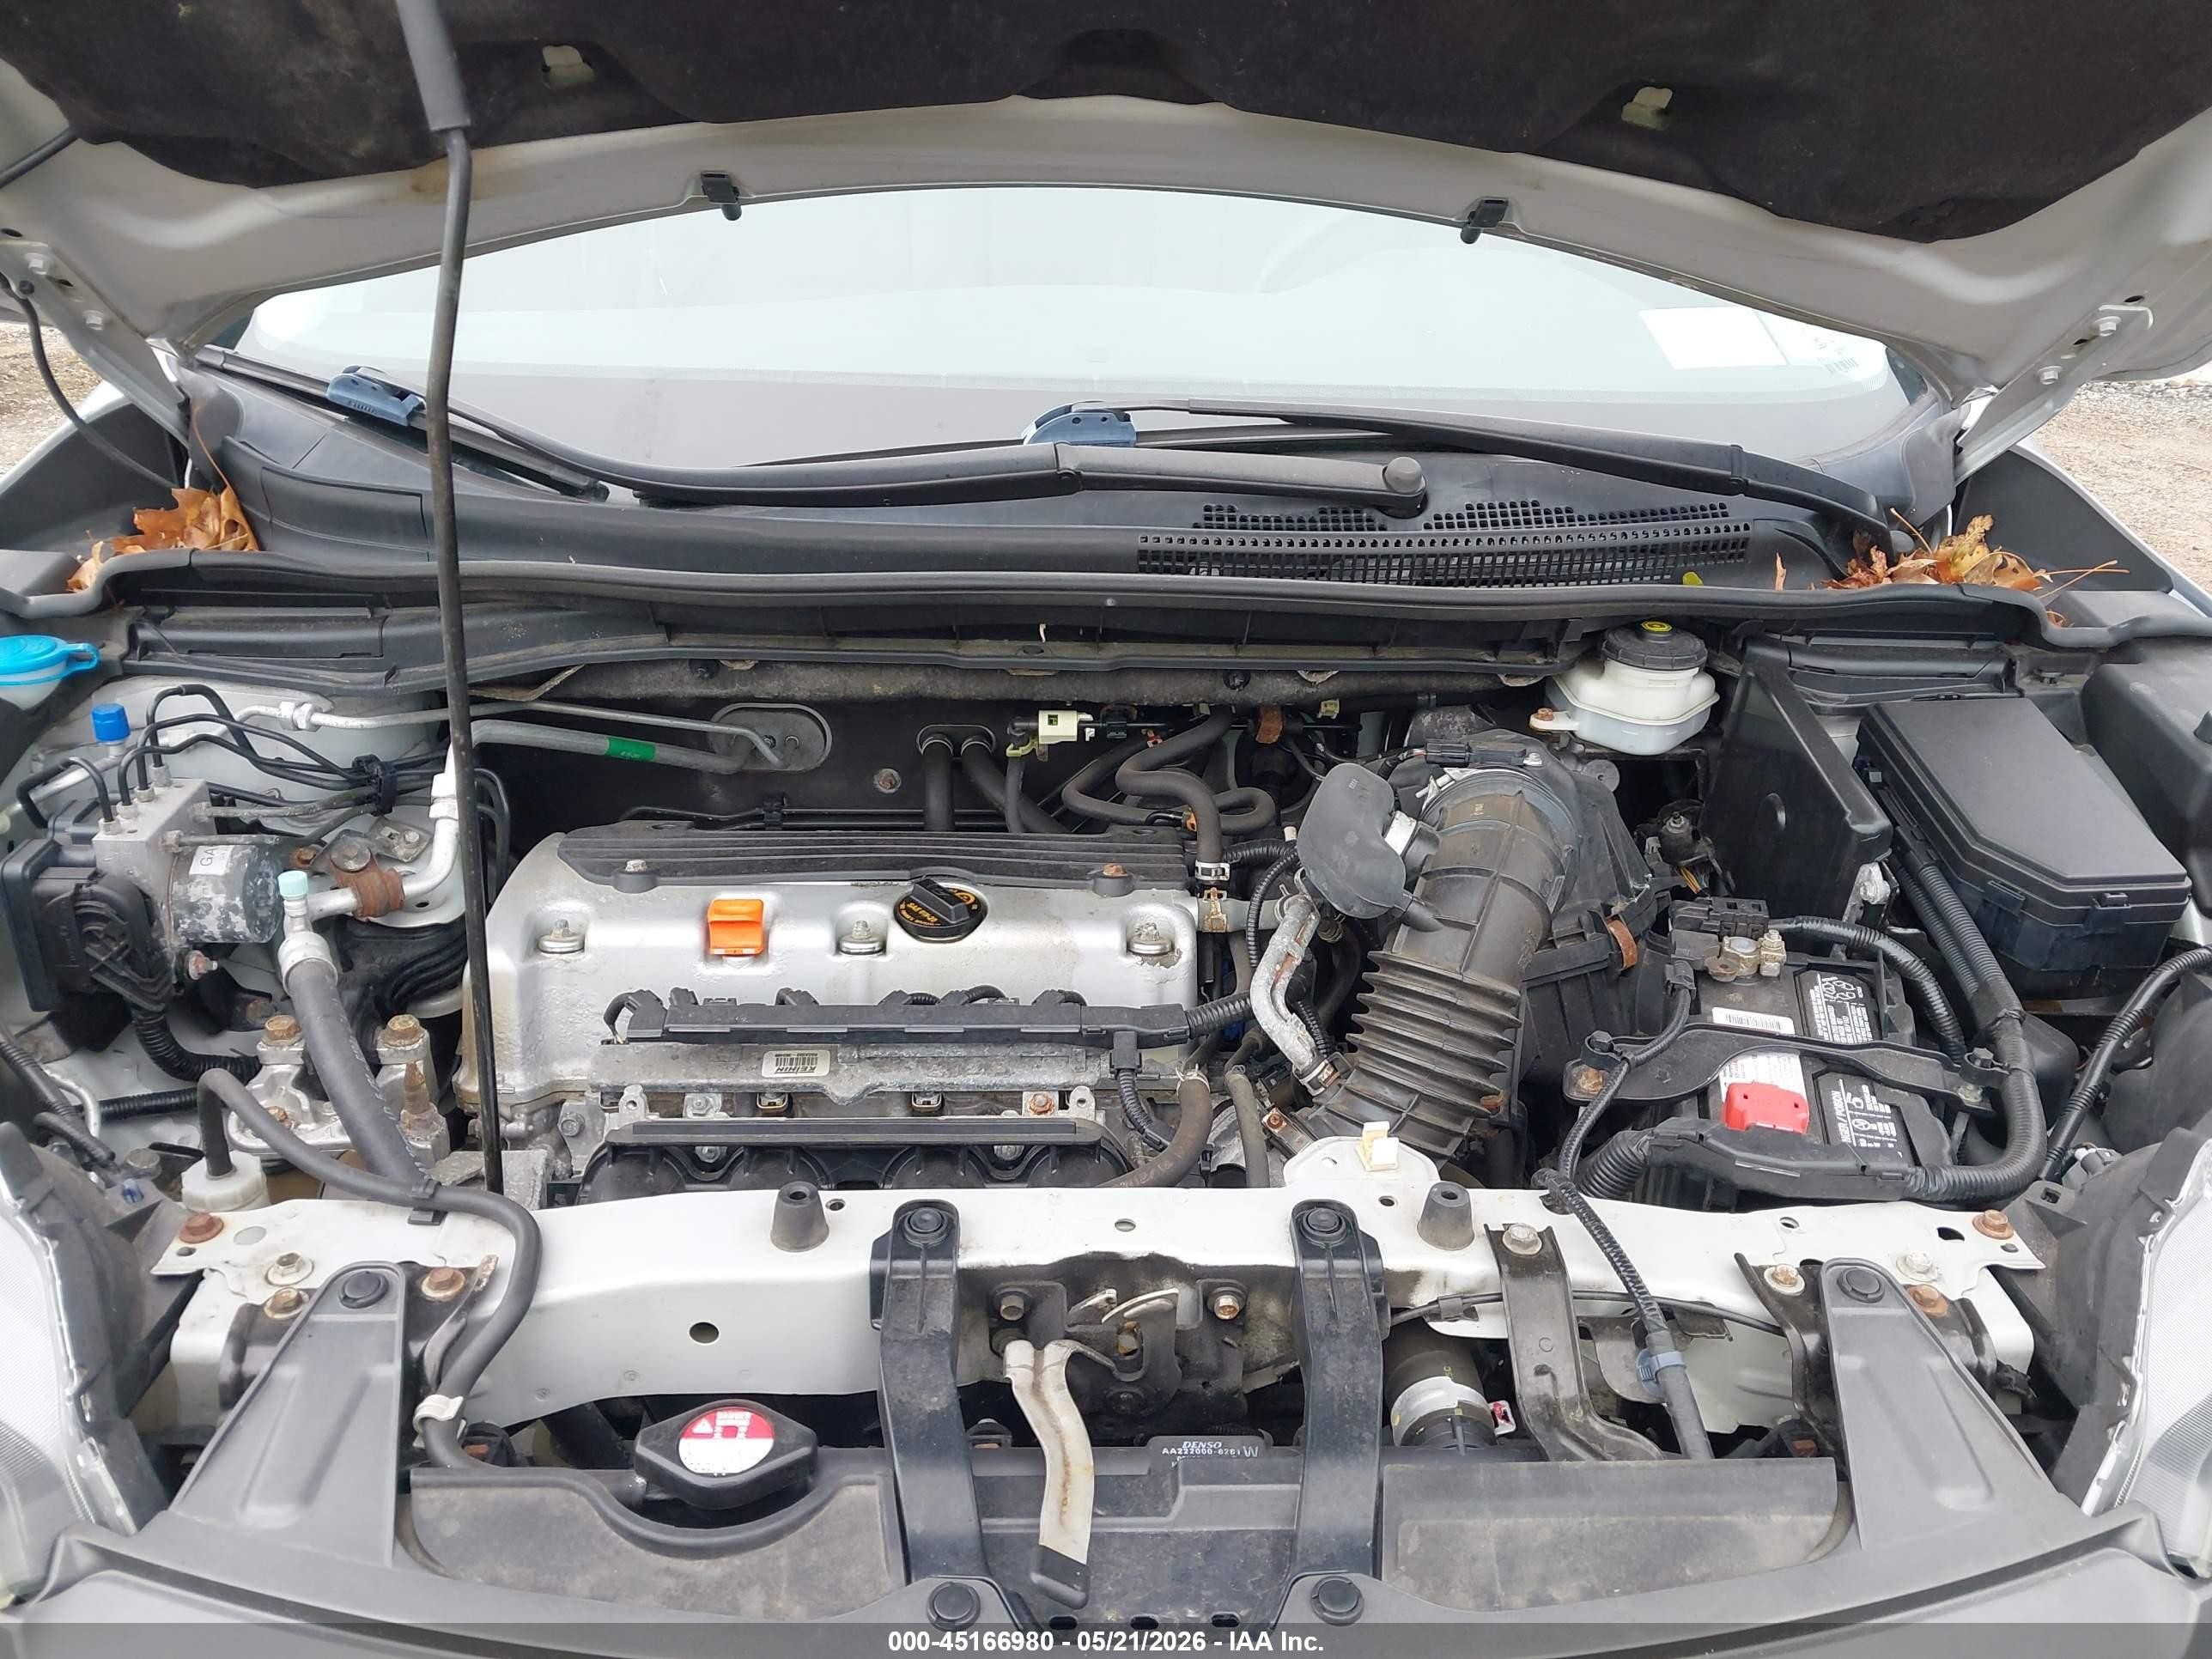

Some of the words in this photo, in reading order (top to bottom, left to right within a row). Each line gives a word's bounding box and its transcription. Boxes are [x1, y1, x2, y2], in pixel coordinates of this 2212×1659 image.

[775, 1066, 817, 1074] KEIHIN
[1831, 1091, 1846, 1116] POISON
[1182, 1441, 1223, 1449] DENSO
